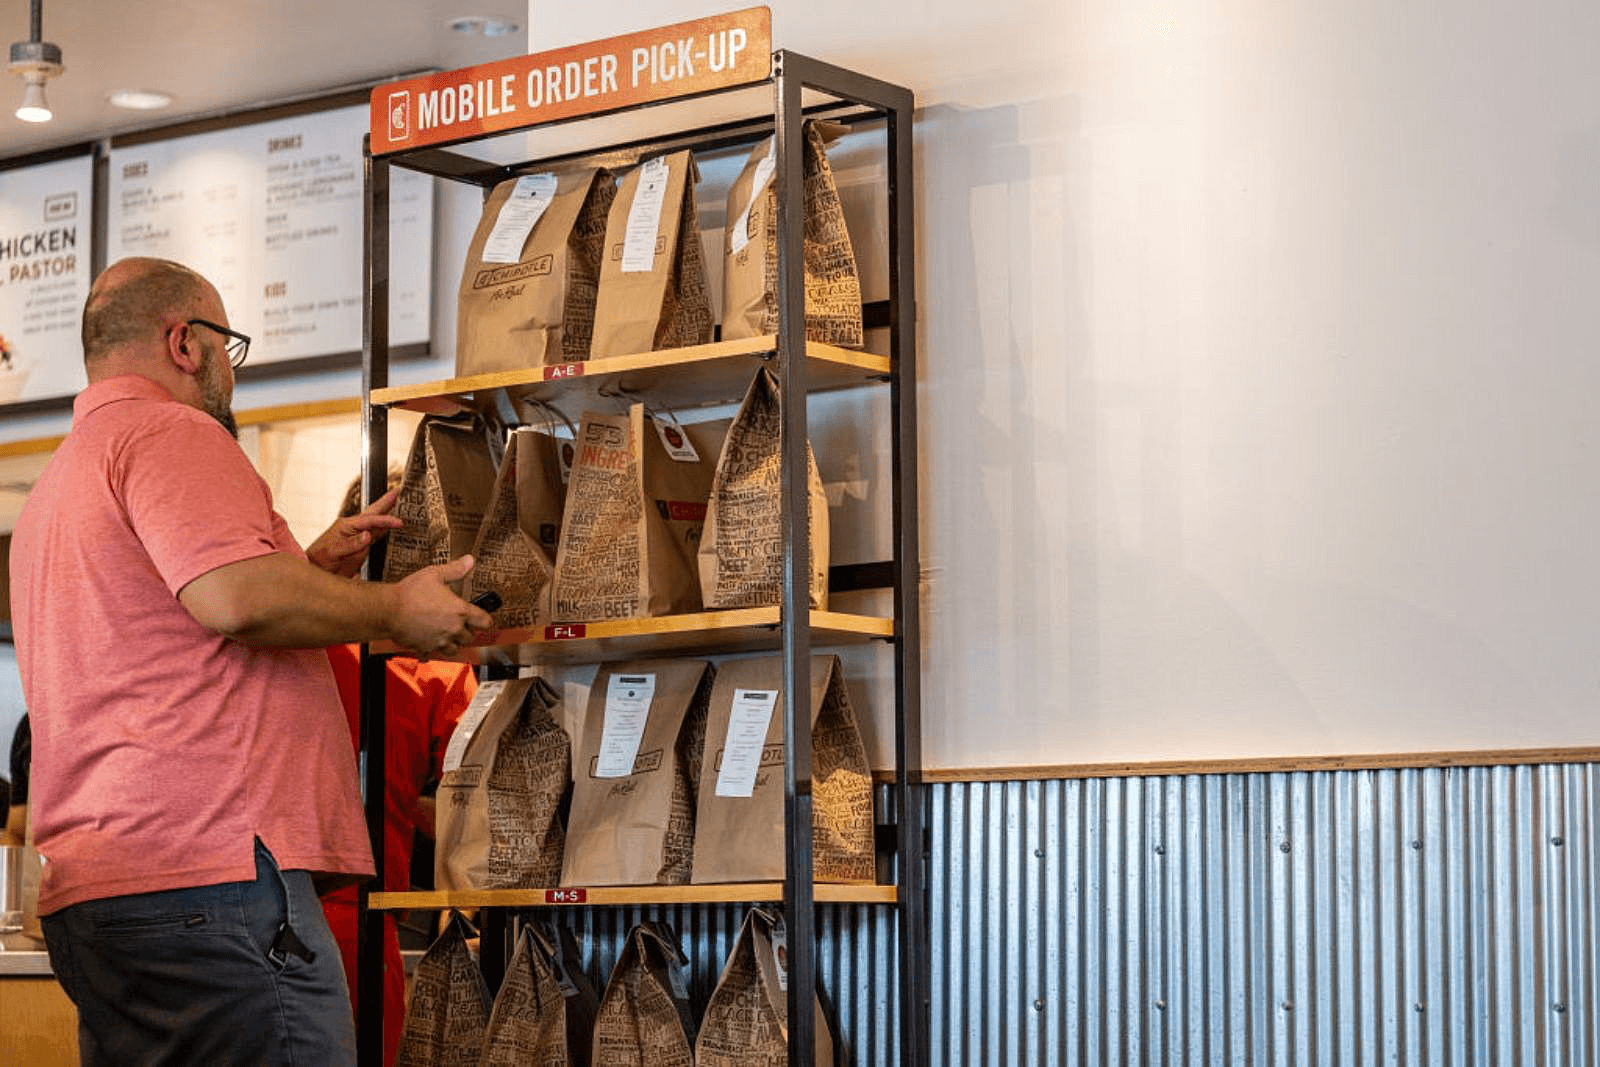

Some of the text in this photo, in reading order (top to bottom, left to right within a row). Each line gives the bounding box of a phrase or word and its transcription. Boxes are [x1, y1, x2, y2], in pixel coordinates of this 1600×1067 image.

[418, 27, 747, 130] MOBILE ORDER PICK-UP
[10, 254, 77, 281] PASTOR
[552, 365, 576, 377] A-E
[719, 559, 747, 573] BEEF
[557, 599, 579, 614] MILK
[604, 599, 639, 618] BEEF
[554, 626, 576, 638] F-L
[553, 890, 578, 902] M-S
